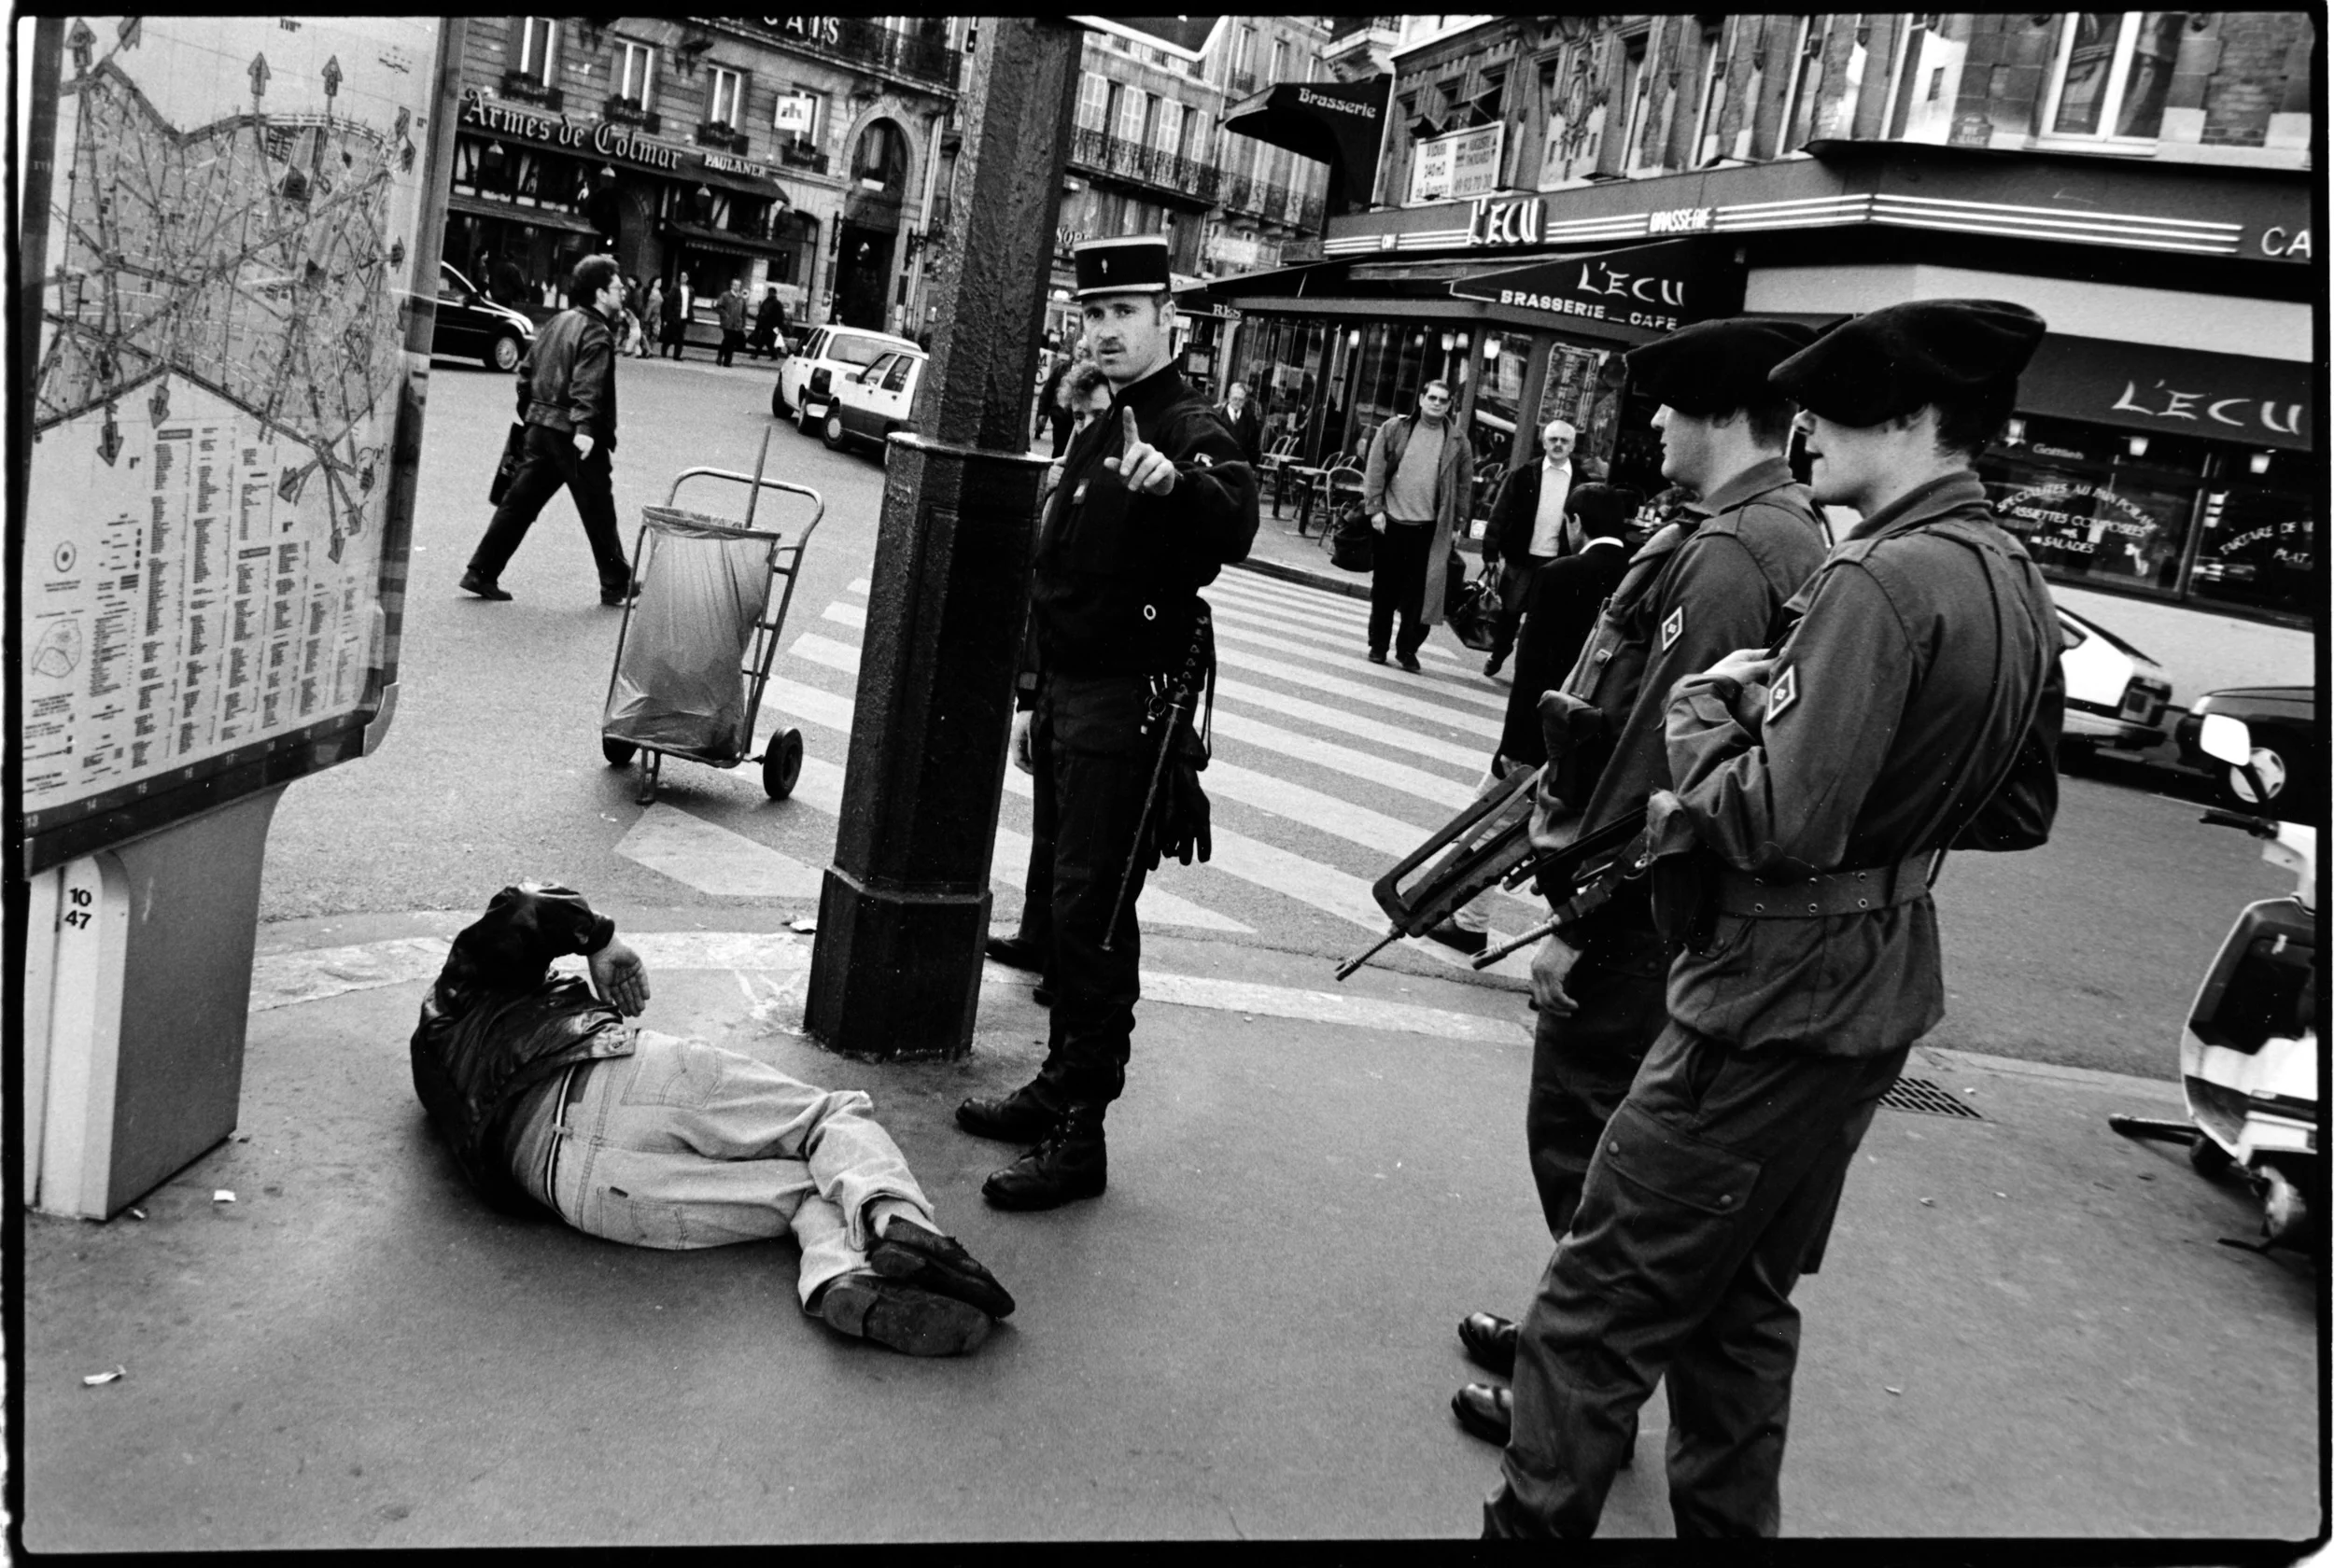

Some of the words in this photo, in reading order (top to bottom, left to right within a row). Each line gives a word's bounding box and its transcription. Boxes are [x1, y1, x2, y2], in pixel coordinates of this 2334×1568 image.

[1299, 87, 1377, 119] Brasserie
[464, 90, 551, 141] Armes
[559, 113, 585, 148] de
[595, 121, 682, 171] Colmar
[704, 154, 766, 178] PAULANER
[1466, 197, 1540, 245] L'ECU
[1650, 206, 1713, 232] BRASSERIE
[2261, 226, 2312, 259] CA
[1577, 261, 1684, 308] L'ECU
[1500, 289, 1606, 320] BRASSERIE
[2111, 379, 2303, 436] L'ECU
[2072, 483, 2093, 496] AU
[2280, 522, 2297, 533] DE
[2041, 536, 2095, 553] SALADES
[2272, 548, 2311, 564] PLAT
[69, 888, 92, 907] 10
[64, 910, 92, 930] 47
